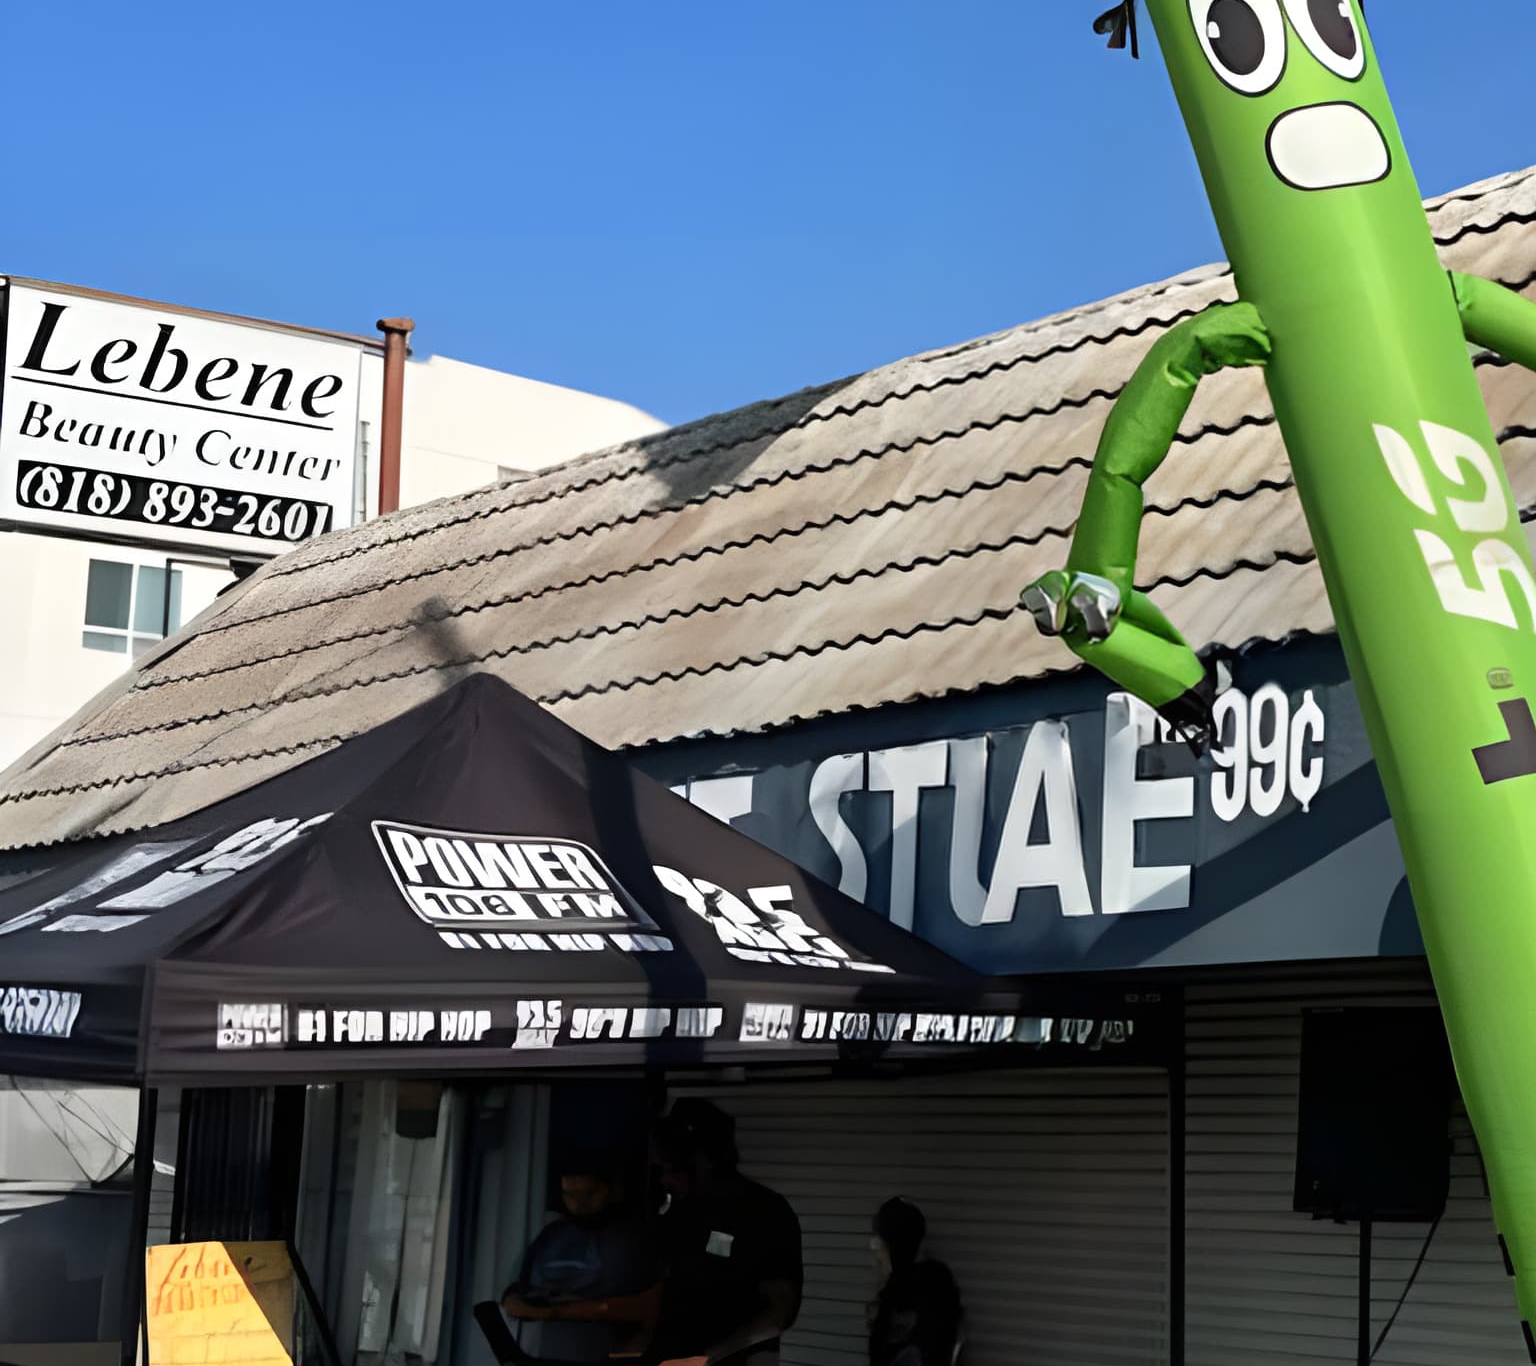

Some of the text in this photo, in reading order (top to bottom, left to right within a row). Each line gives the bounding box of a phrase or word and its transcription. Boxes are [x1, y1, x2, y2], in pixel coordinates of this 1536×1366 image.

[17, 300, 344, 419] Lebene
[19, 400, 341, 481] Beauty Center
[19, 465, 331, 541] (818) 893-2601
[386, 829, 611, 890] POWER
